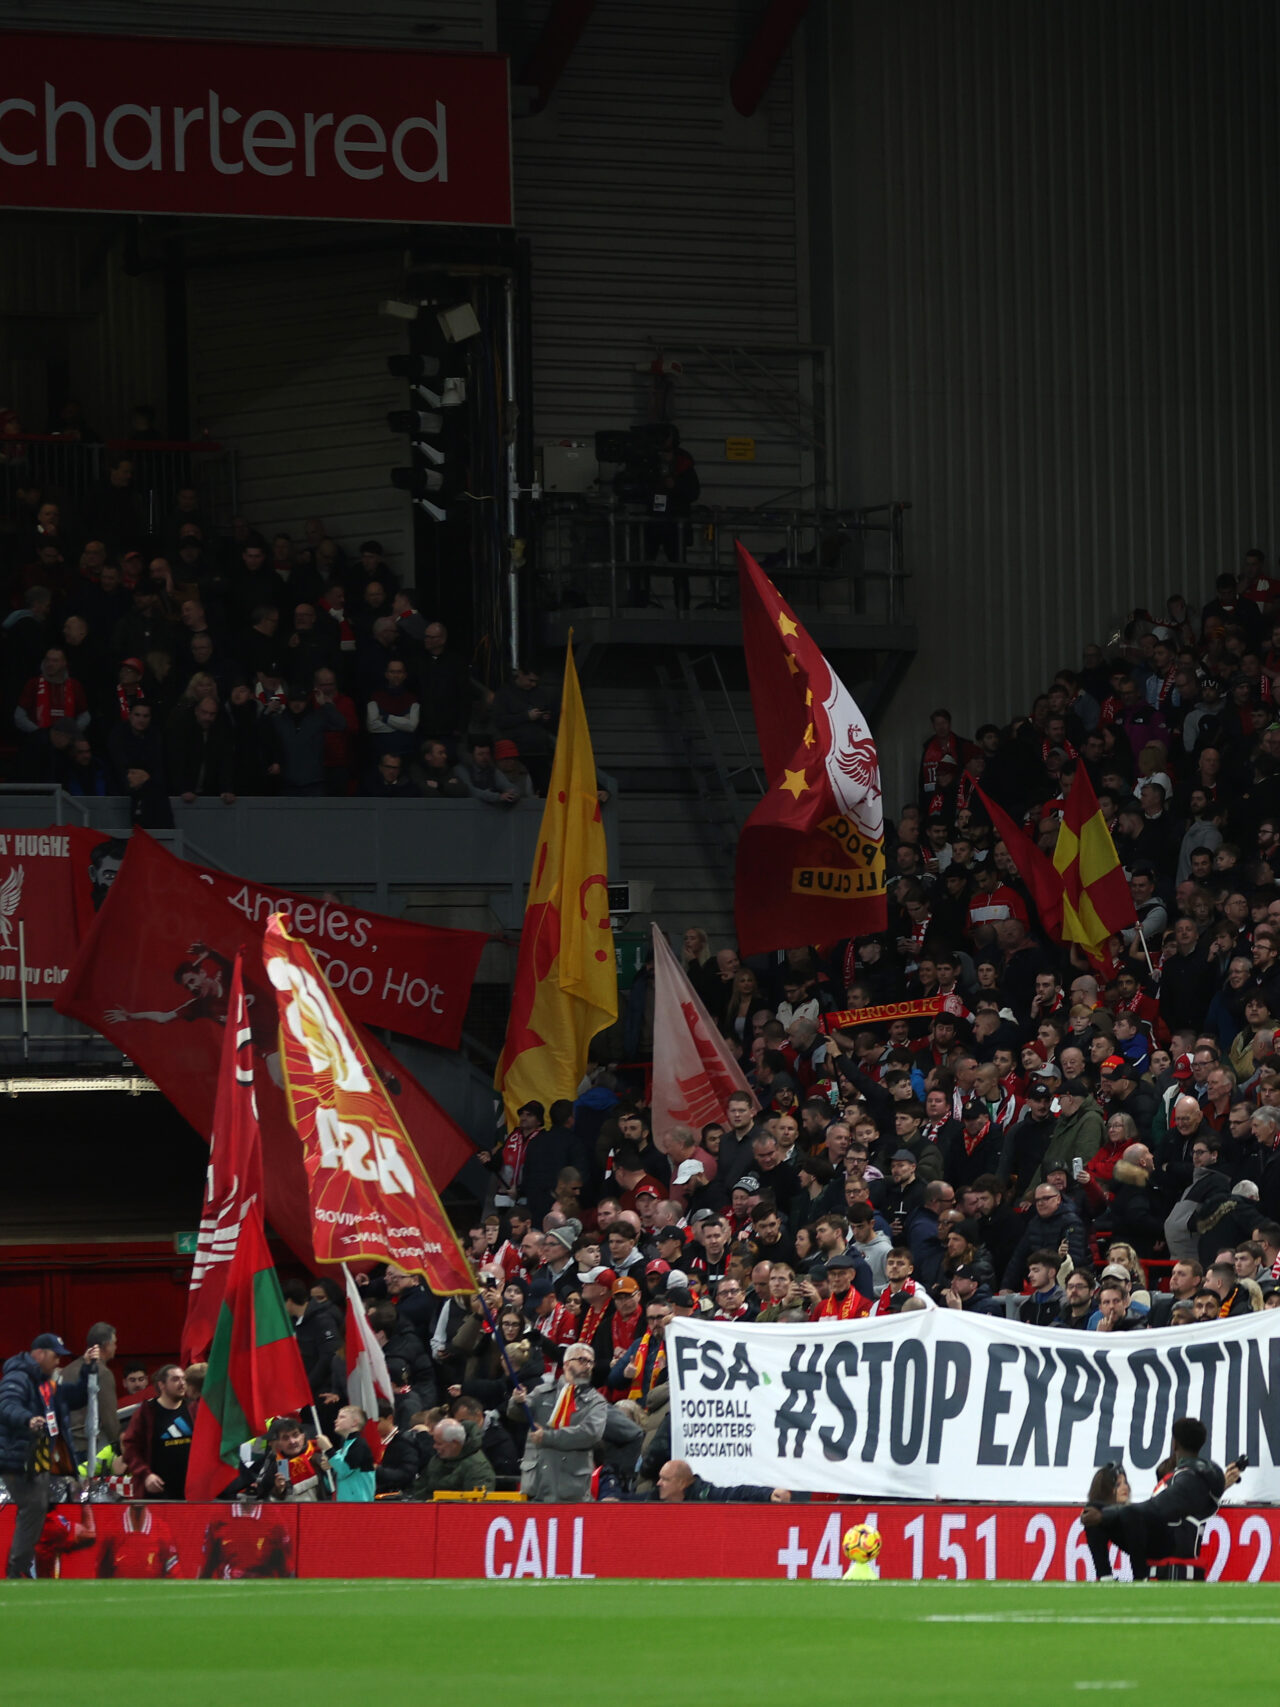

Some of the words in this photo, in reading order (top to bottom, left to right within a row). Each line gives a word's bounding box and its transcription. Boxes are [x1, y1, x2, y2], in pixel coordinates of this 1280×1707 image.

[0, 82, 449, 183] chartered
[837, 999, 920, 1024] LIVERPOOL
[922, 998, 940, 1012] FC
[674, 1336, 760, 1391] FSA
[681, 1399, 752, 1418] FOOTBALL
[774, 1338, 972, 1464] #STOP
[684, 1442, 753, 1458] ASSOCIATION
[484, 1516, 596, 1579] CALL
[904, 1513, 997, 1580] 151
